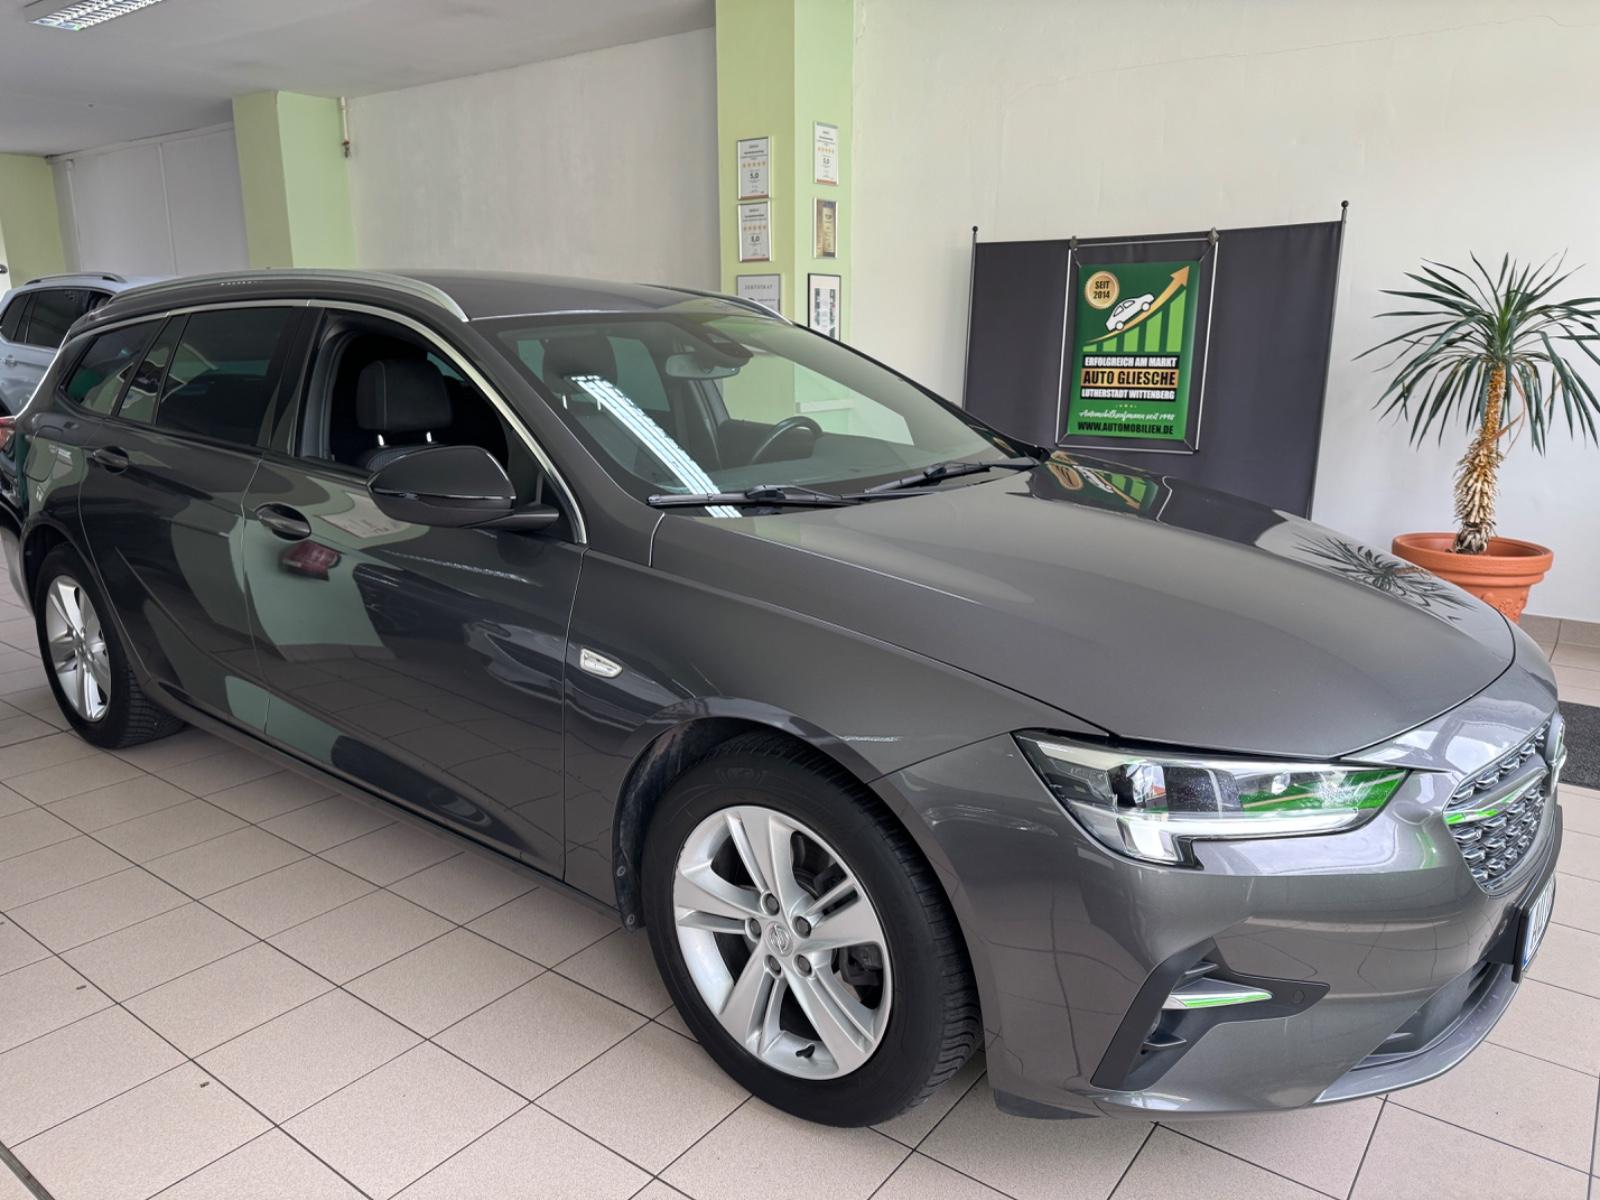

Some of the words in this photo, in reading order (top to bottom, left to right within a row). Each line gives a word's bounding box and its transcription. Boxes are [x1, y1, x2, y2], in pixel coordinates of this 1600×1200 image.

[1095, 280, 1110, 290] SEIT
[1093, 290, 1110, 299] 2014
[1084, 356, 1135, 367] ERFOLGREICH
[1135, 357, 1148, 367] AM
[1148, 357, 1178, 368] MARKT
[1083, 370, 1115, 385] AUTO
[1117, 370, 1177, 386] GLIESCHE
[1081, 388, 1128, 399] LUTHERSTADT
[1128, 389, 1175, 400] WITTENBERG
[1145, 411, 1158, 421] seit
[1077, 422, 1174, 435] WWW.AUTOMOBILIEN.DE
